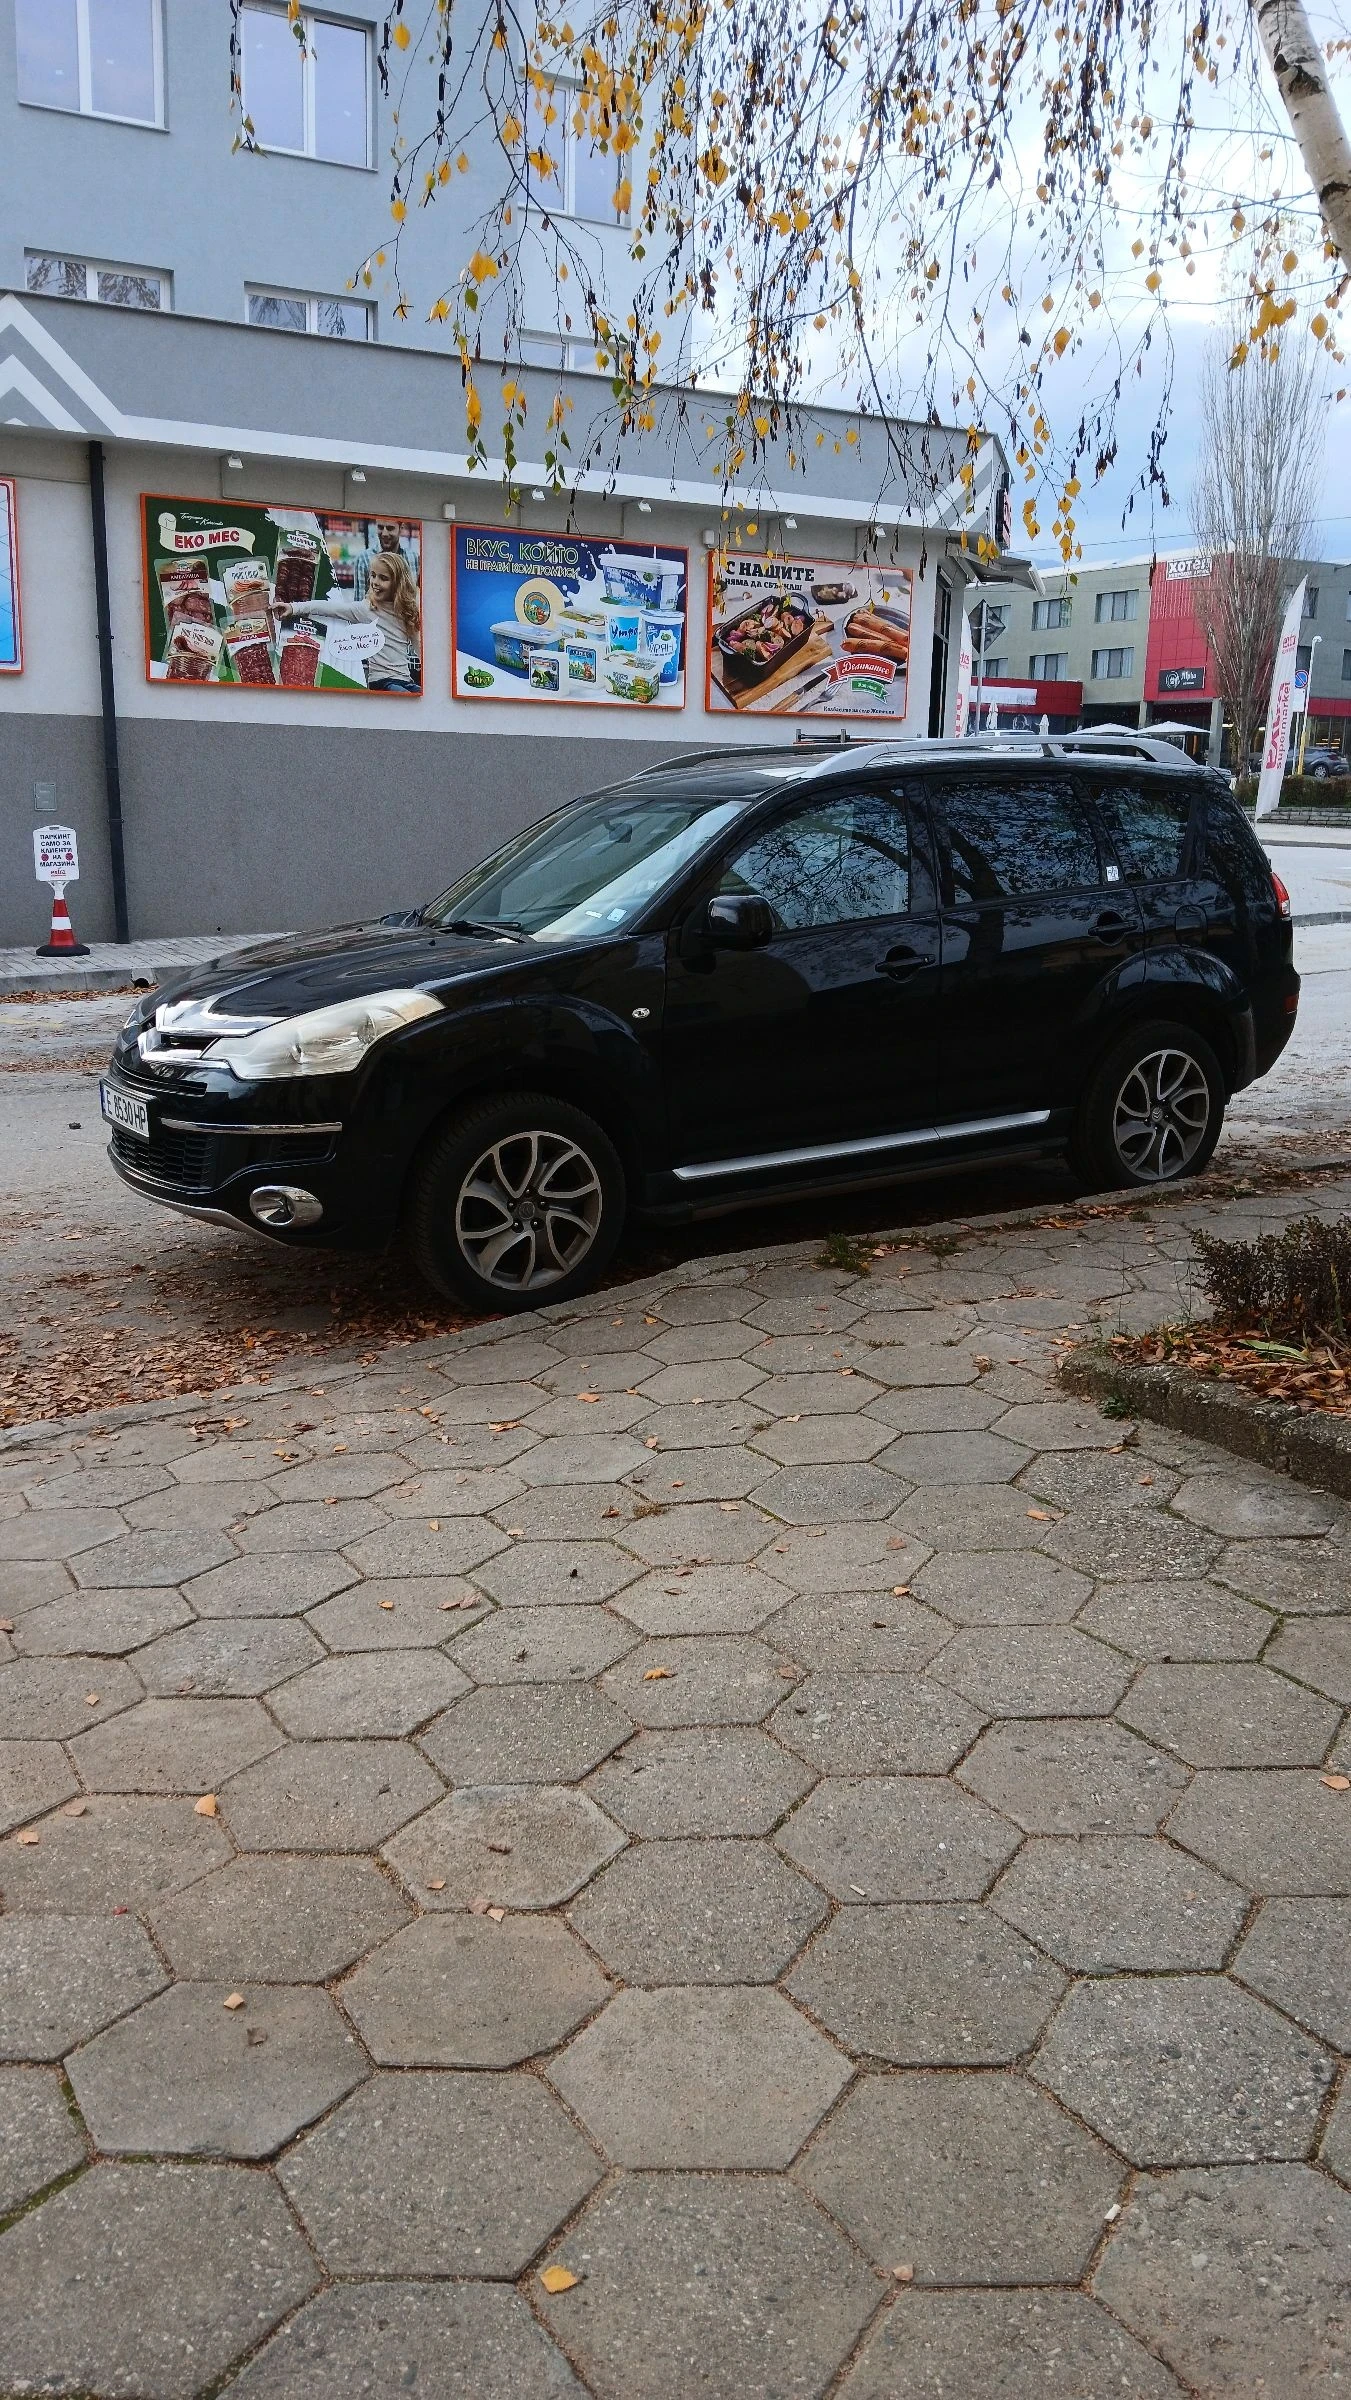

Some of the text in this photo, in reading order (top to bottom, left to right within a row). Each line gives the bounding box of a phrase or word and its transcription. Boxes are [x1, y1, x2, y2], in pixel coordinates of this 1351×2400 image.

[208, 530, 240, 545] МЕС
[519, 541, 579, 565] КОЙТО
[465, 558, 479, 570] НЕ
[479, 560, 511, 573] ПРАВИ
[726, 560, 815, 582] С НАШИТЕ
[725, 578, 803, 591] НЯМА ДА СБЪКАШ
[841, 661, 890, 675] Деликатес
[1276, 681, 1292, 770] supermarket
[106, 1089, 113, 1115] E
